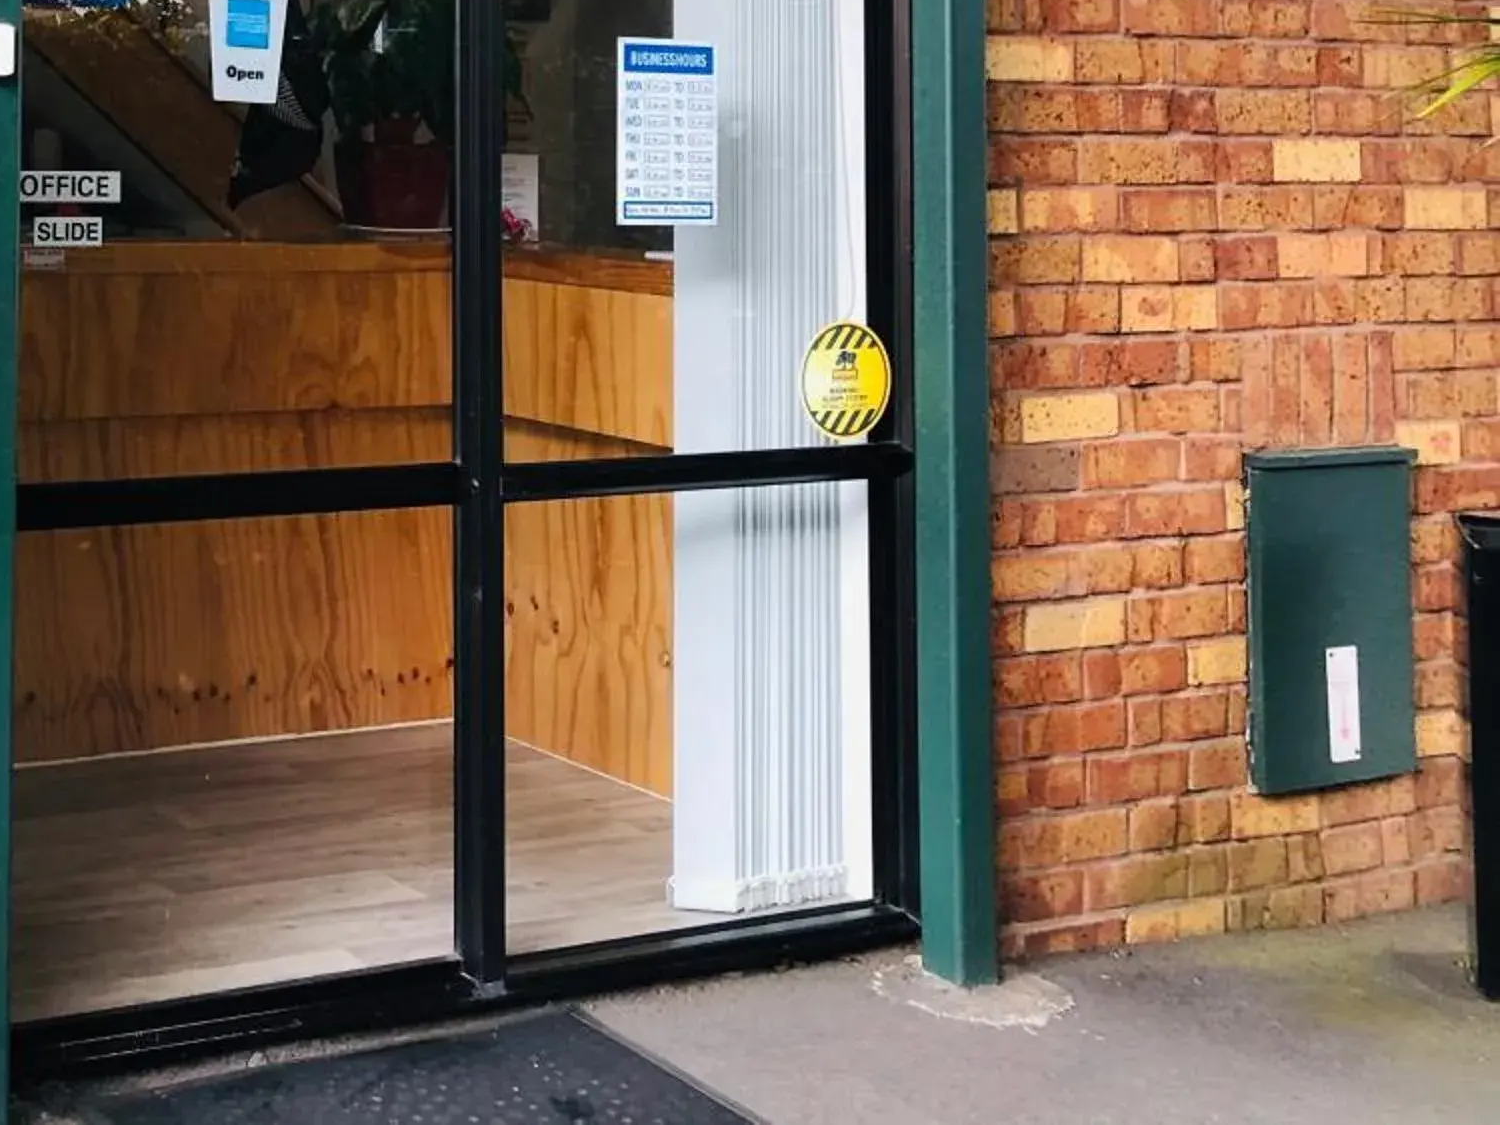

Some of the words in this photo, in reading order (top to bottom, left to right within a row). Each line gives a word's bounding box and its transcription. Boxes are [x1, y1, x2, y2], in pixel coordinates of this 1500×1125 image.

[226, 64, 265, 82] Open
[21, 175, 110, 197] OFFICE
[37, 222, 99, 242] SLIDE
